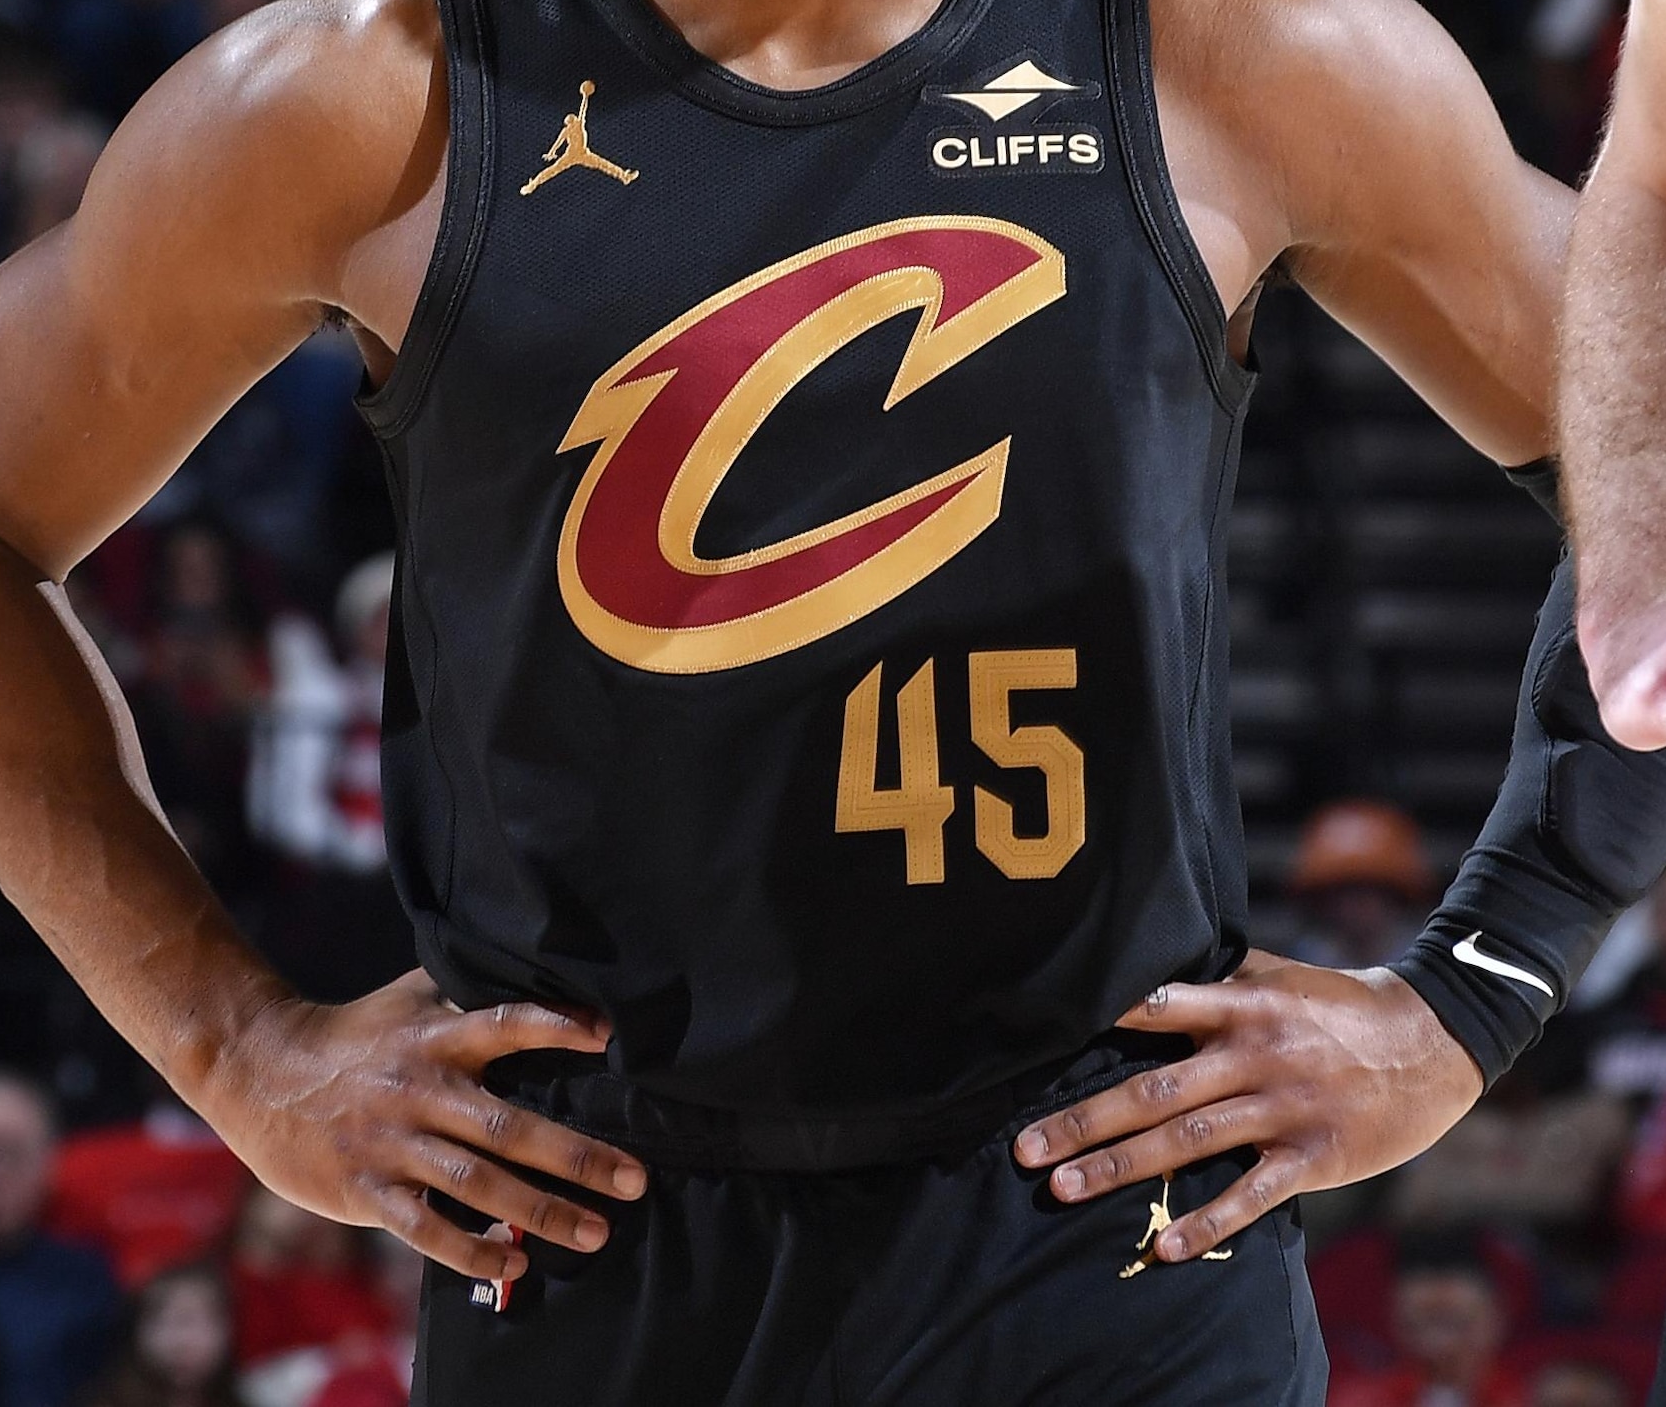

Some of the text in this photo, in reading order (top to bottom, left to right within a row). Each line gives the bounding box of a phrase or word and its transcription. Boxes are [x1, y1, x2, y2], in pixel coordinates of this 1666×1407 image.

[932, 133, 1100, 169] CLIFFS
[556, 214, 1067, 674] C
[834, 648, 1085, 885] 45
[472, 1283, 494, 1305] NBA
